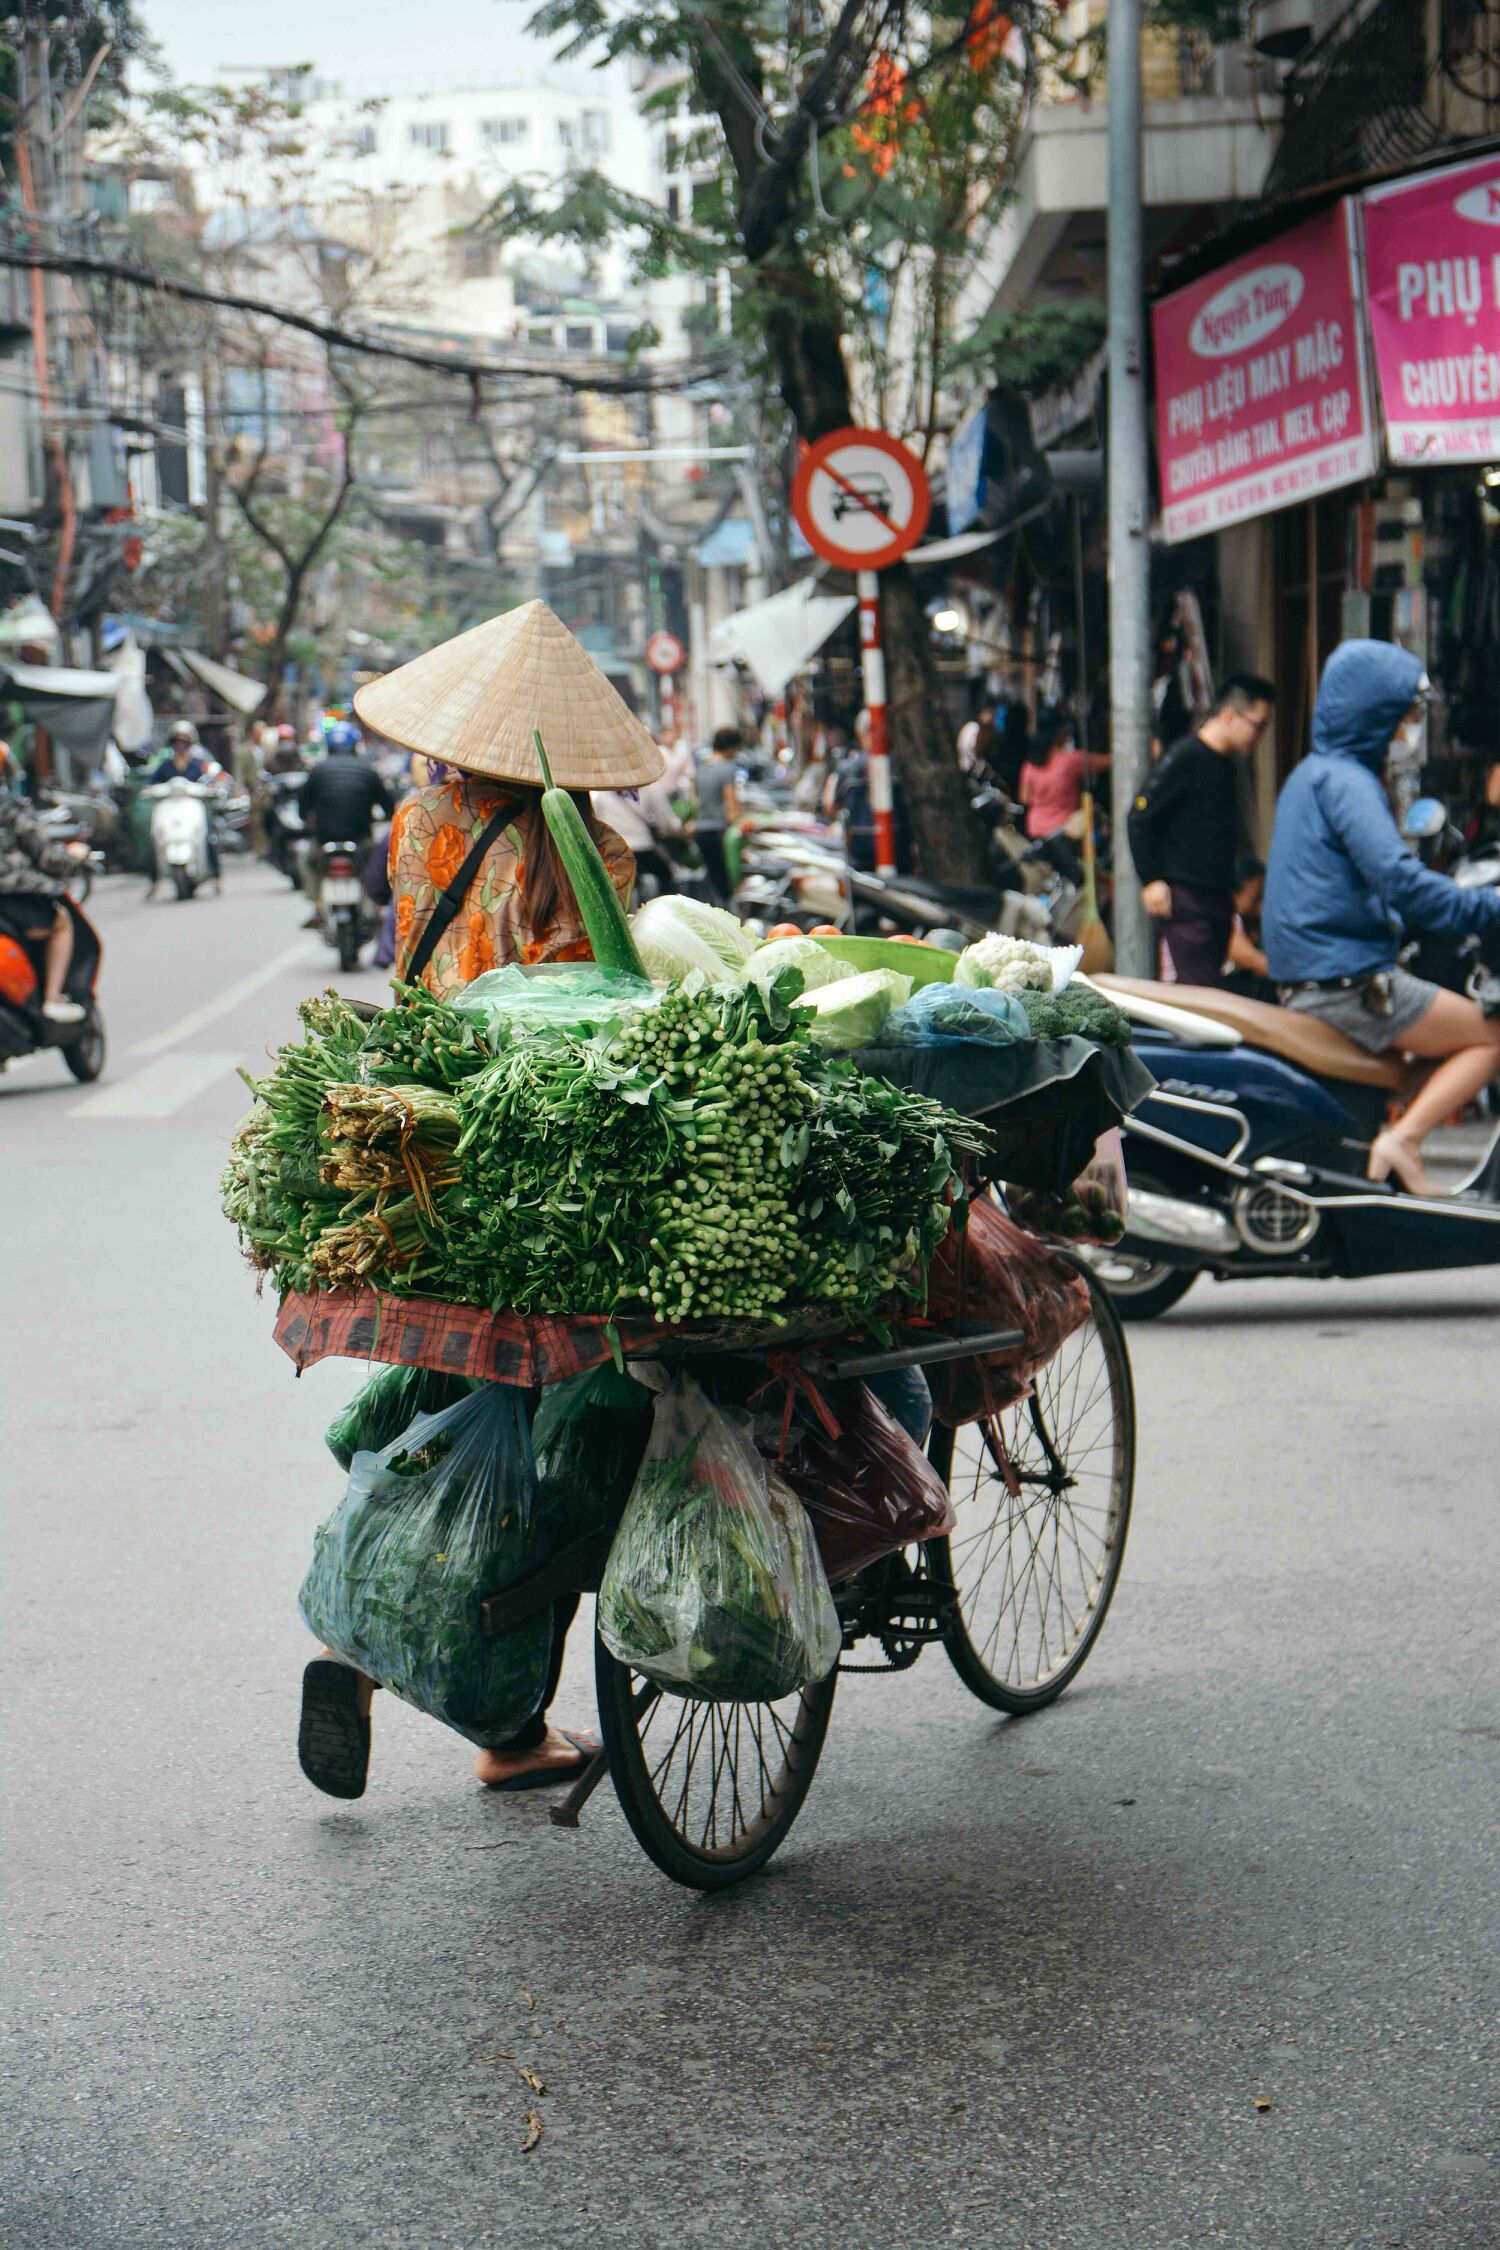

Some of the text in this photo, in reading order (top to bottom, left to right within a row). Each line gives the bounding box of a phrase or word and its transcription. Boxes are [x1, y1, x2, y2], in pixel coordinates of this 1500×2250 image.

[1397, 257, 1482, 326] PHỤ
[1168, 320, 1343, 439] PHỤ LIỆU MAY MẶC
[1401, 343, 1500, 407] CHUYÊN
[1320, 388, 1350, 438] CẠP
